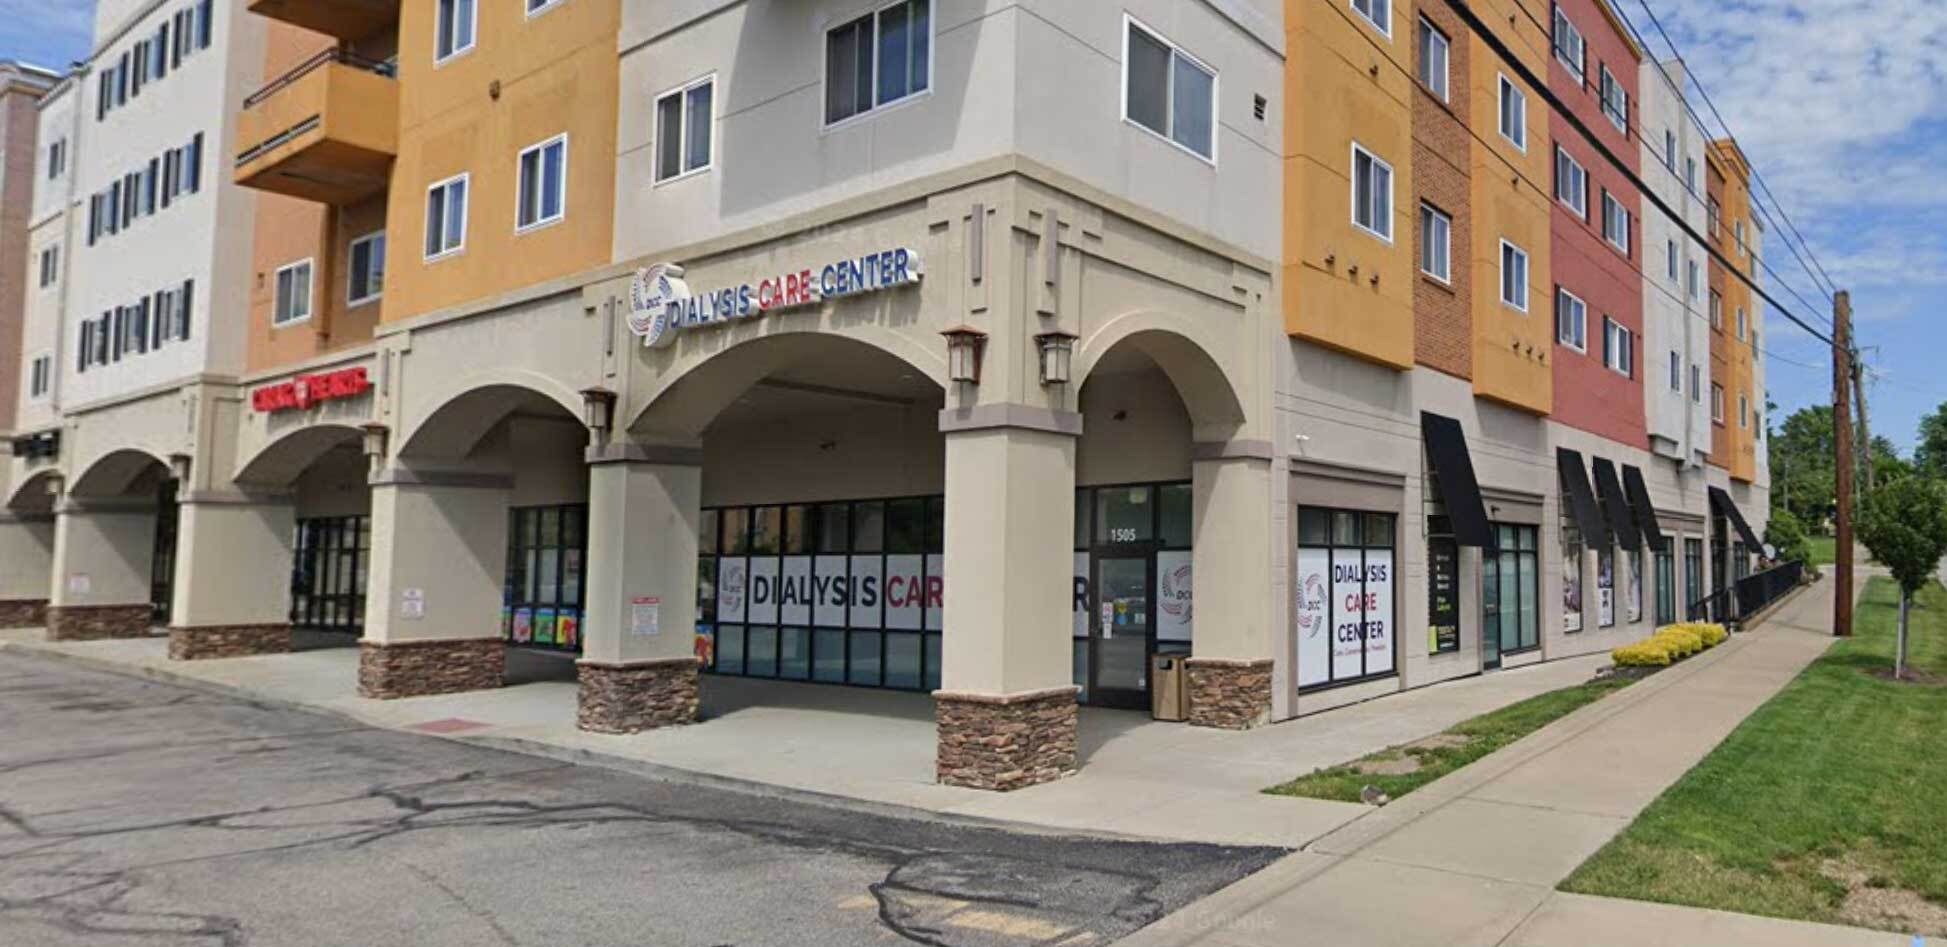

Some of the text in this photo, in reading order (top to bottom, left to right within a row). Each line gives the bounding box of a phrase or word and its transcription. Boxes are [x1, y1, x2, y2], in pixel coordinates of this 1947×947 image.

[667, 247, 910, 328] DIALYSIS CARE CENTER
[1111, 528, 1136, 542] 1505
[753, 575, 943, 608] DIALYSIS CAR
[1345, 592, 1377, 612] CARE
